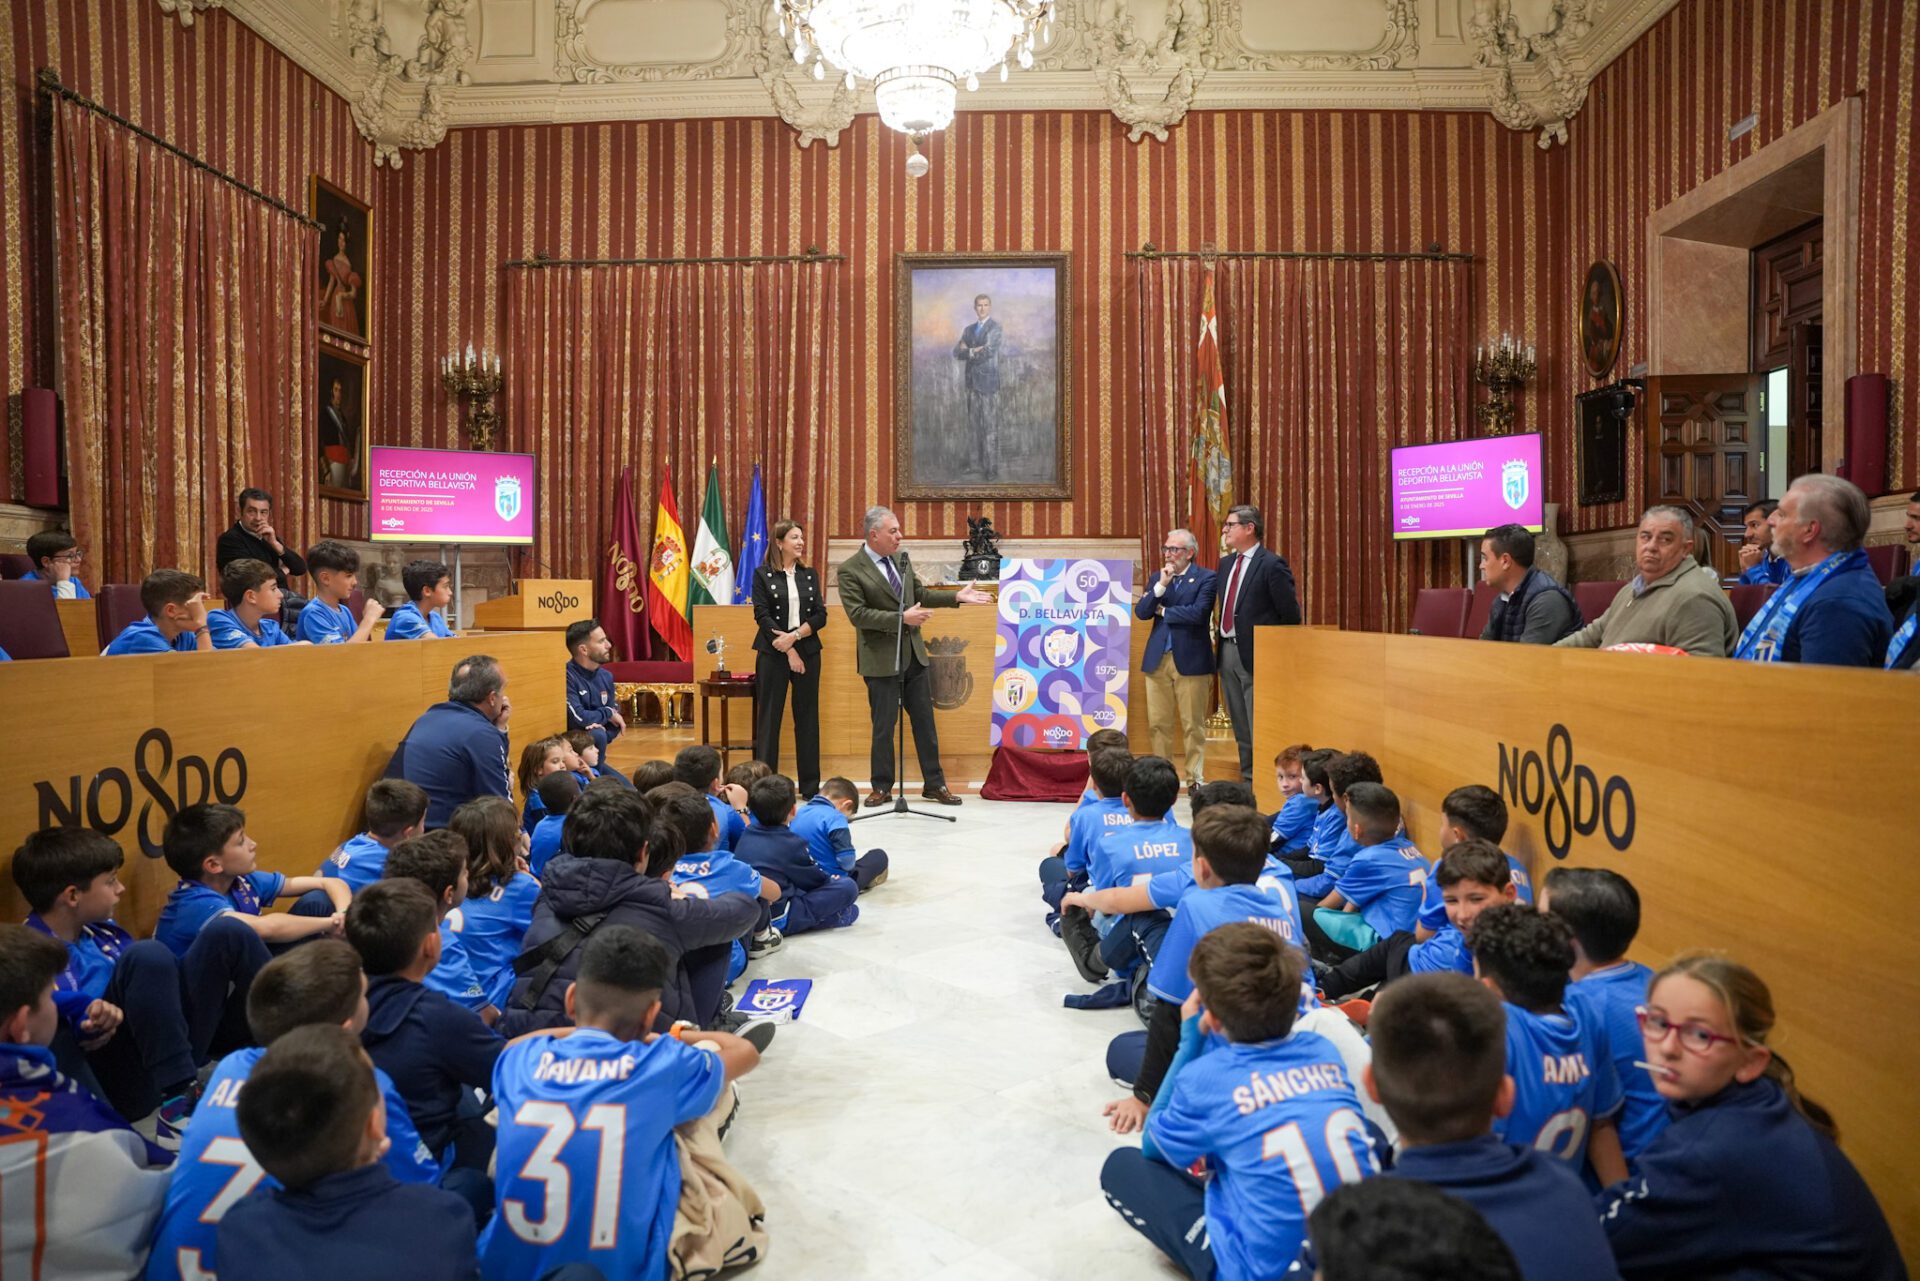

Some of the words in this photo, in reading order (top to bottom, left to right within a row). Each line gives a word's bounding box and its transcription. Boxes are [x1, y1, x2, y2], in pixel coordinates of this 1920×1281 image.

[380, 468, 427, 479] RECEPCIÓN
[449, 471, 477, 481] UNIÓN
[1398, 465, 1438, 476] RECEPCIÓN
[1446, 464, 1456, 472] LA
[1458, 461, 1484, 472] UNIÓN
[380, 478, 426, 488] DEPORTIVA
[428, 480, 475, 490] BELLAVISTA
[1398, 476, 1438, 486] DEPORTIVA
[1440, 472, 1482, 482] BELLAVISTA
[1080, 576, 1098, 588] 50
[1020, 608, 1030, 618] D.
[1035, 608, 1104, 619] BELLAVISTA
[1095, 665, 1118, 675] 1975
[1093, 710, 1115, 720] 2025
[1103, 814, 1134, 826] ISAA
[1133, 841, 1180, 860] LÓPEZ
[1232, 1064, 1346, 1115] SÁNCHEZ
[504, 1100, 626, 1249] 31
